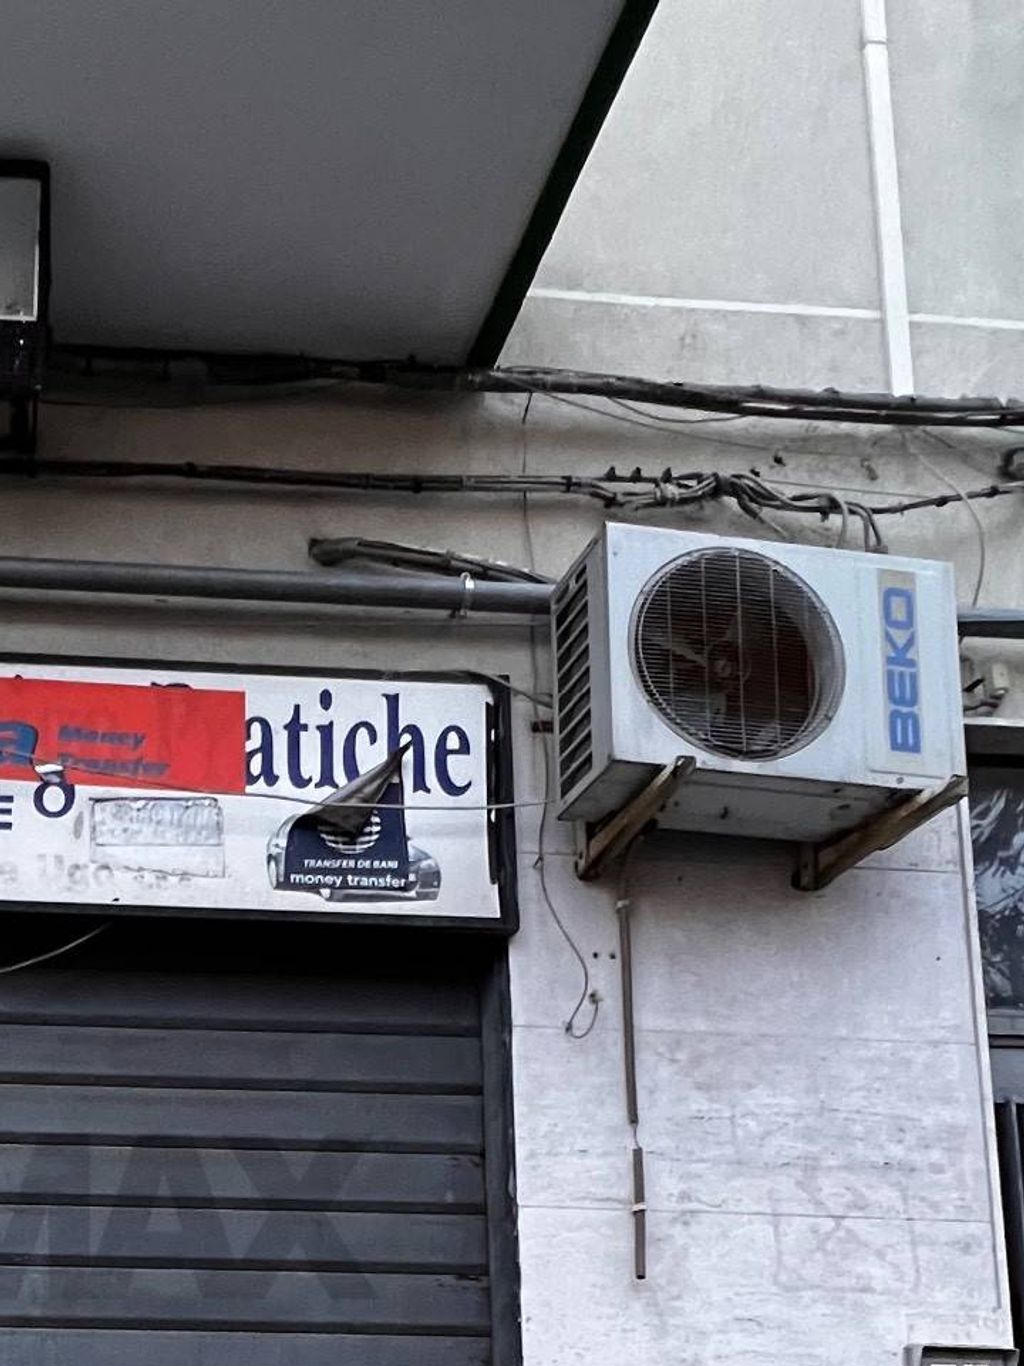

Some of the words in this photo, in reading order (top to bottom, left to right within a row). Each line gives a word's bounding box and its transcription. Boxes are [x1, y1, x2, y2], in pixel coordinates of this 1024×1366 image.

[884, 587, 922, 754] BEKO
[244, 688, 473, 797] atiche
[290, 873, 343, 887] money
[347, 874, 406, 888] transfer
[304, 859, 355, 869] TRANSFER
[357, 859, 370, 869] DE
[373, 860, 398, 869] BANI
